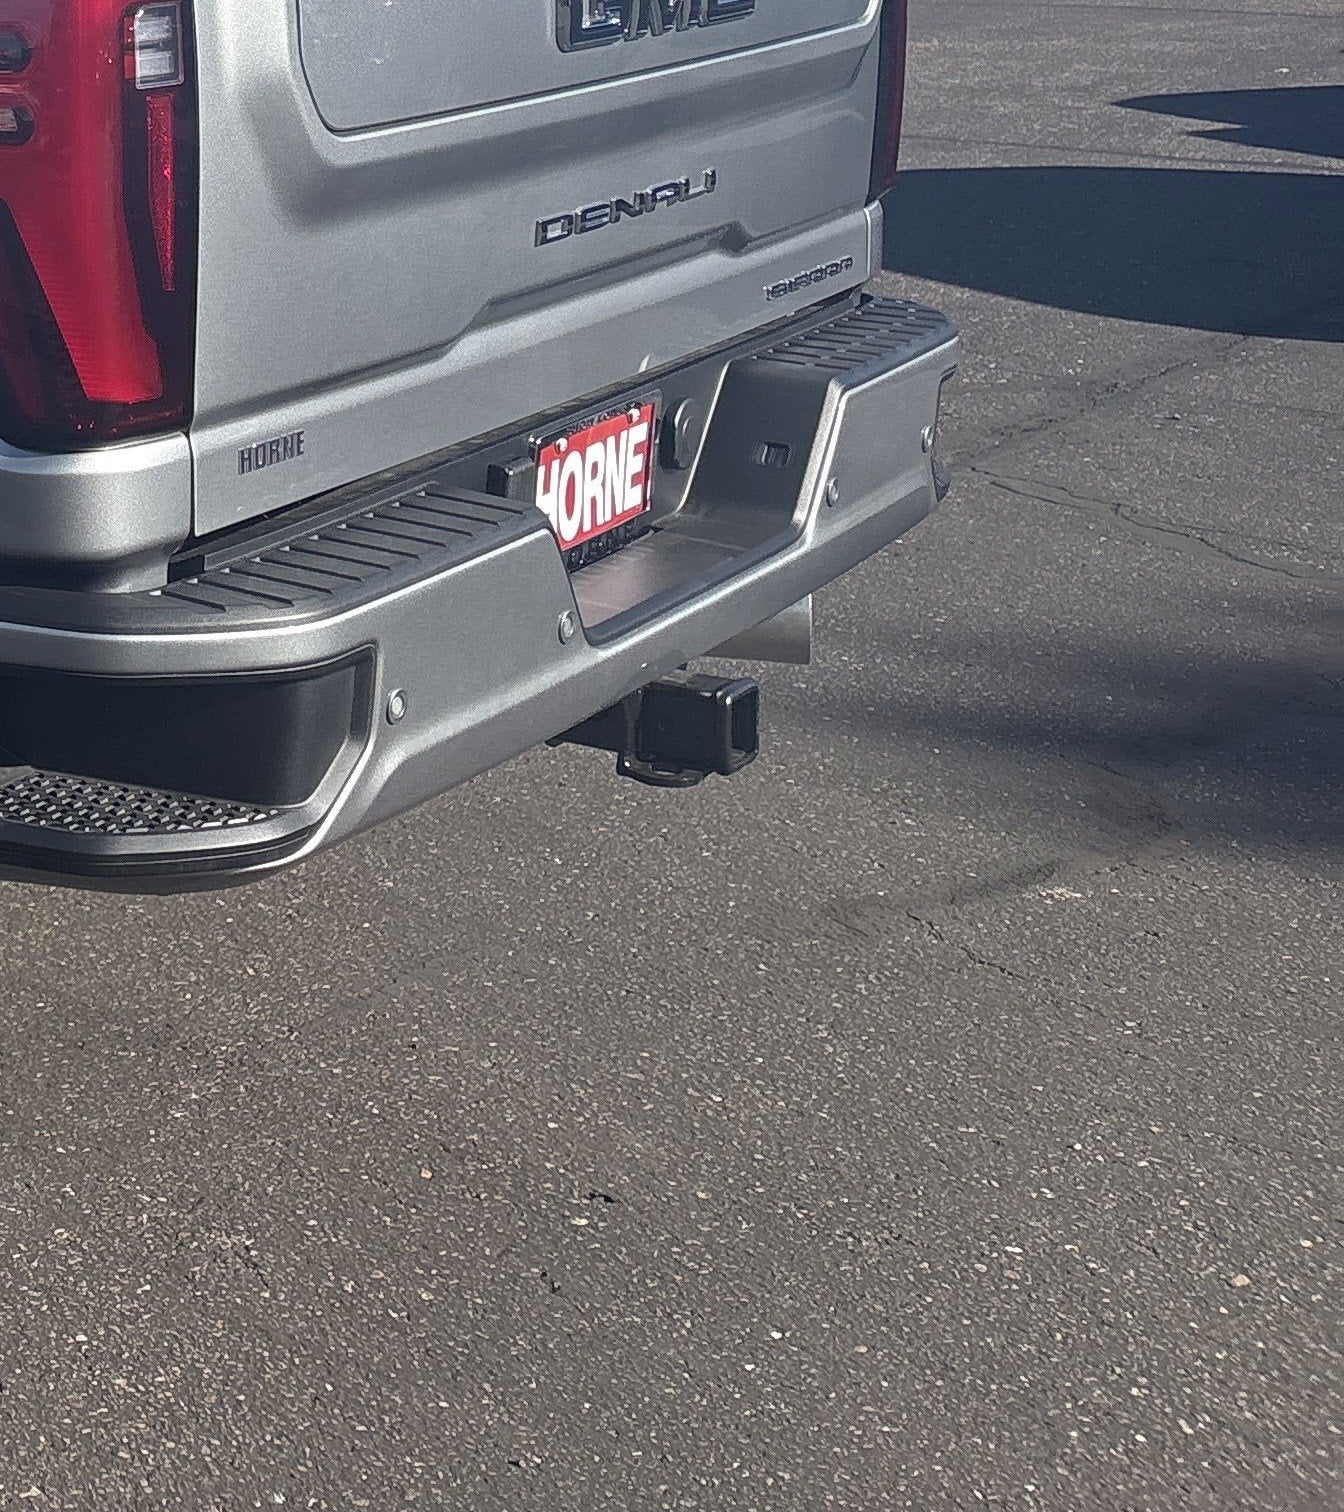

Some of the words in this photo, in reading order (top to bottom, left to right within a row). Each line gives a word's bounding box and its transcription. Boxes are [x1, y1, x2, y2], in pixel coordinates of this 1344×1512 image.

[533, 167, 717, 248] DENALI
[237, 428, 305, 476] HORNE
[535, 421, 650, 542] HORNE
